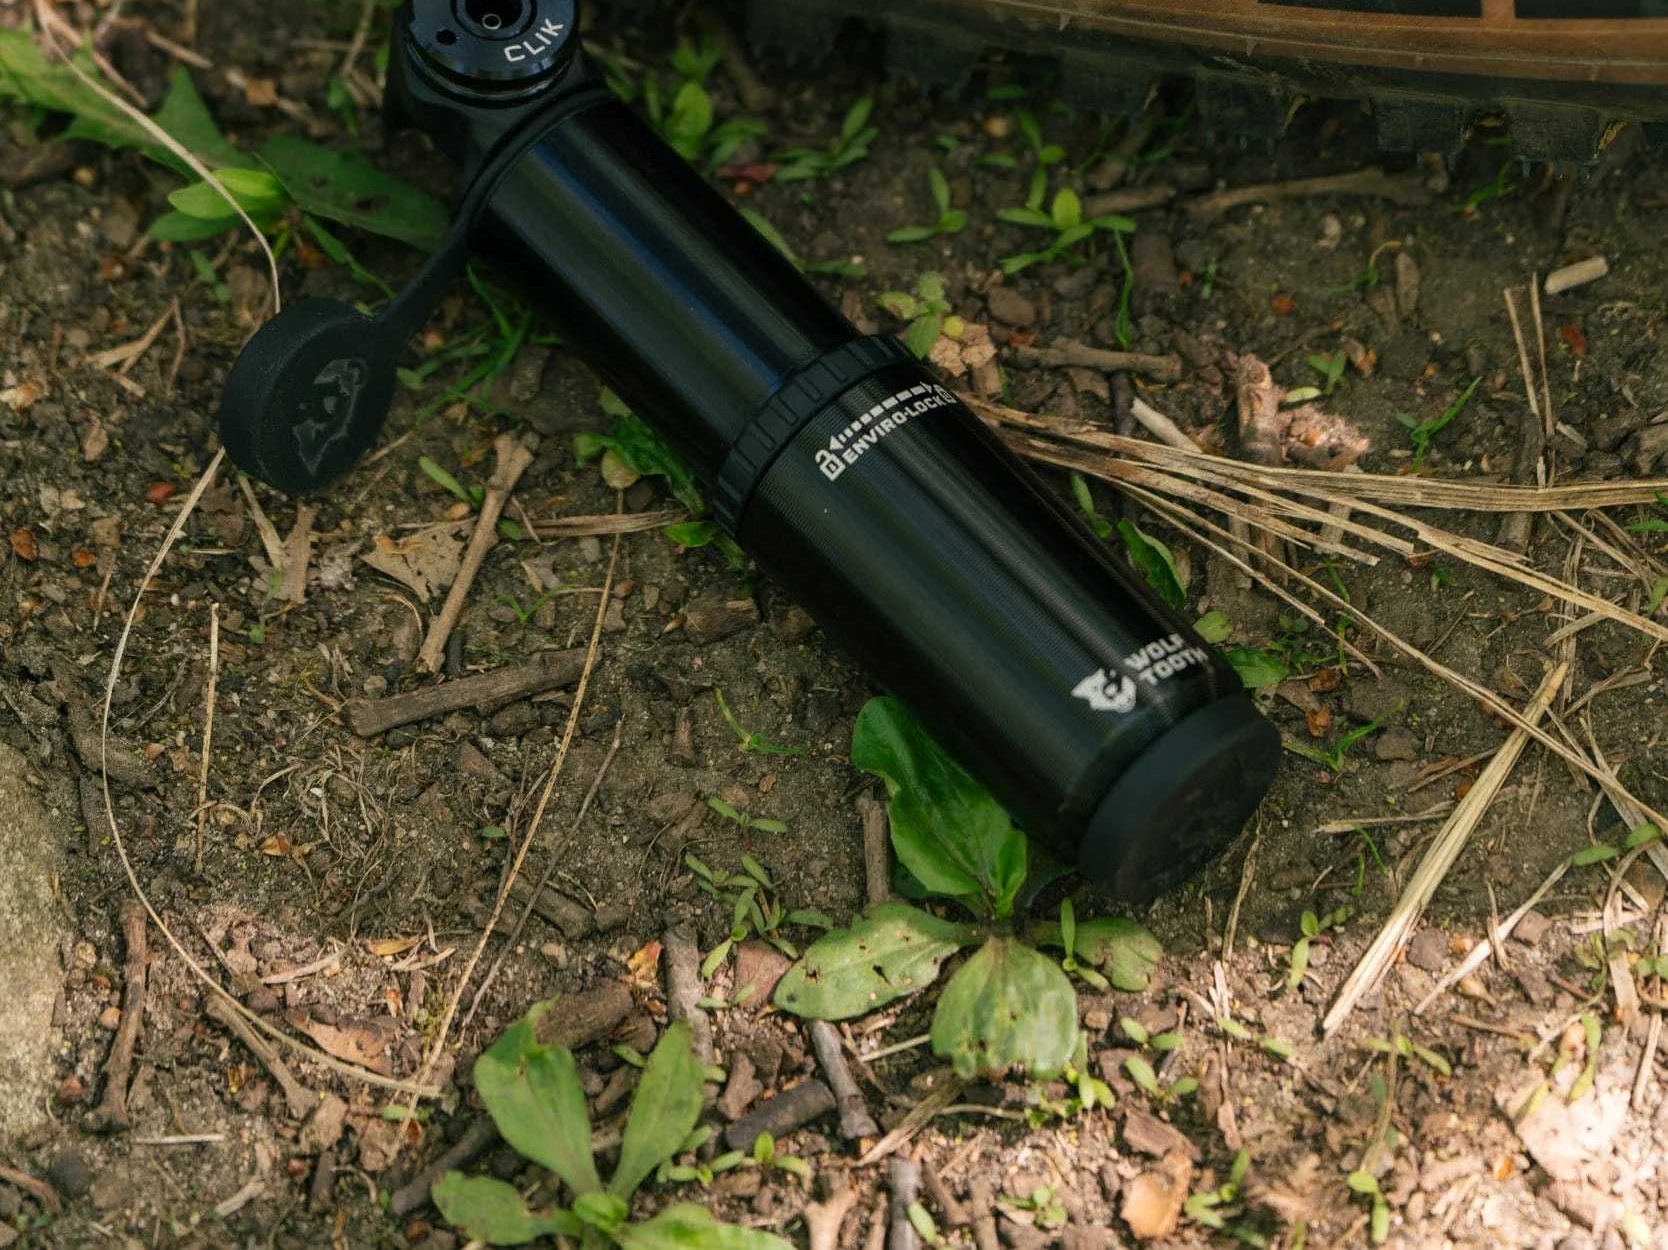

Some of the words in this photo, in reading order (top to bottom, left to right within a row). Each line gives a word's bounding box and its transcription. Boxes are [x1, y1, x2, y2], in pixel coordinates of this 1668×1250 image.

[504, 18, 564, 62] CLIK
[1124, 633, 1184, 671] WOLF
[1138, 648, 1209, 686] TOOTH
